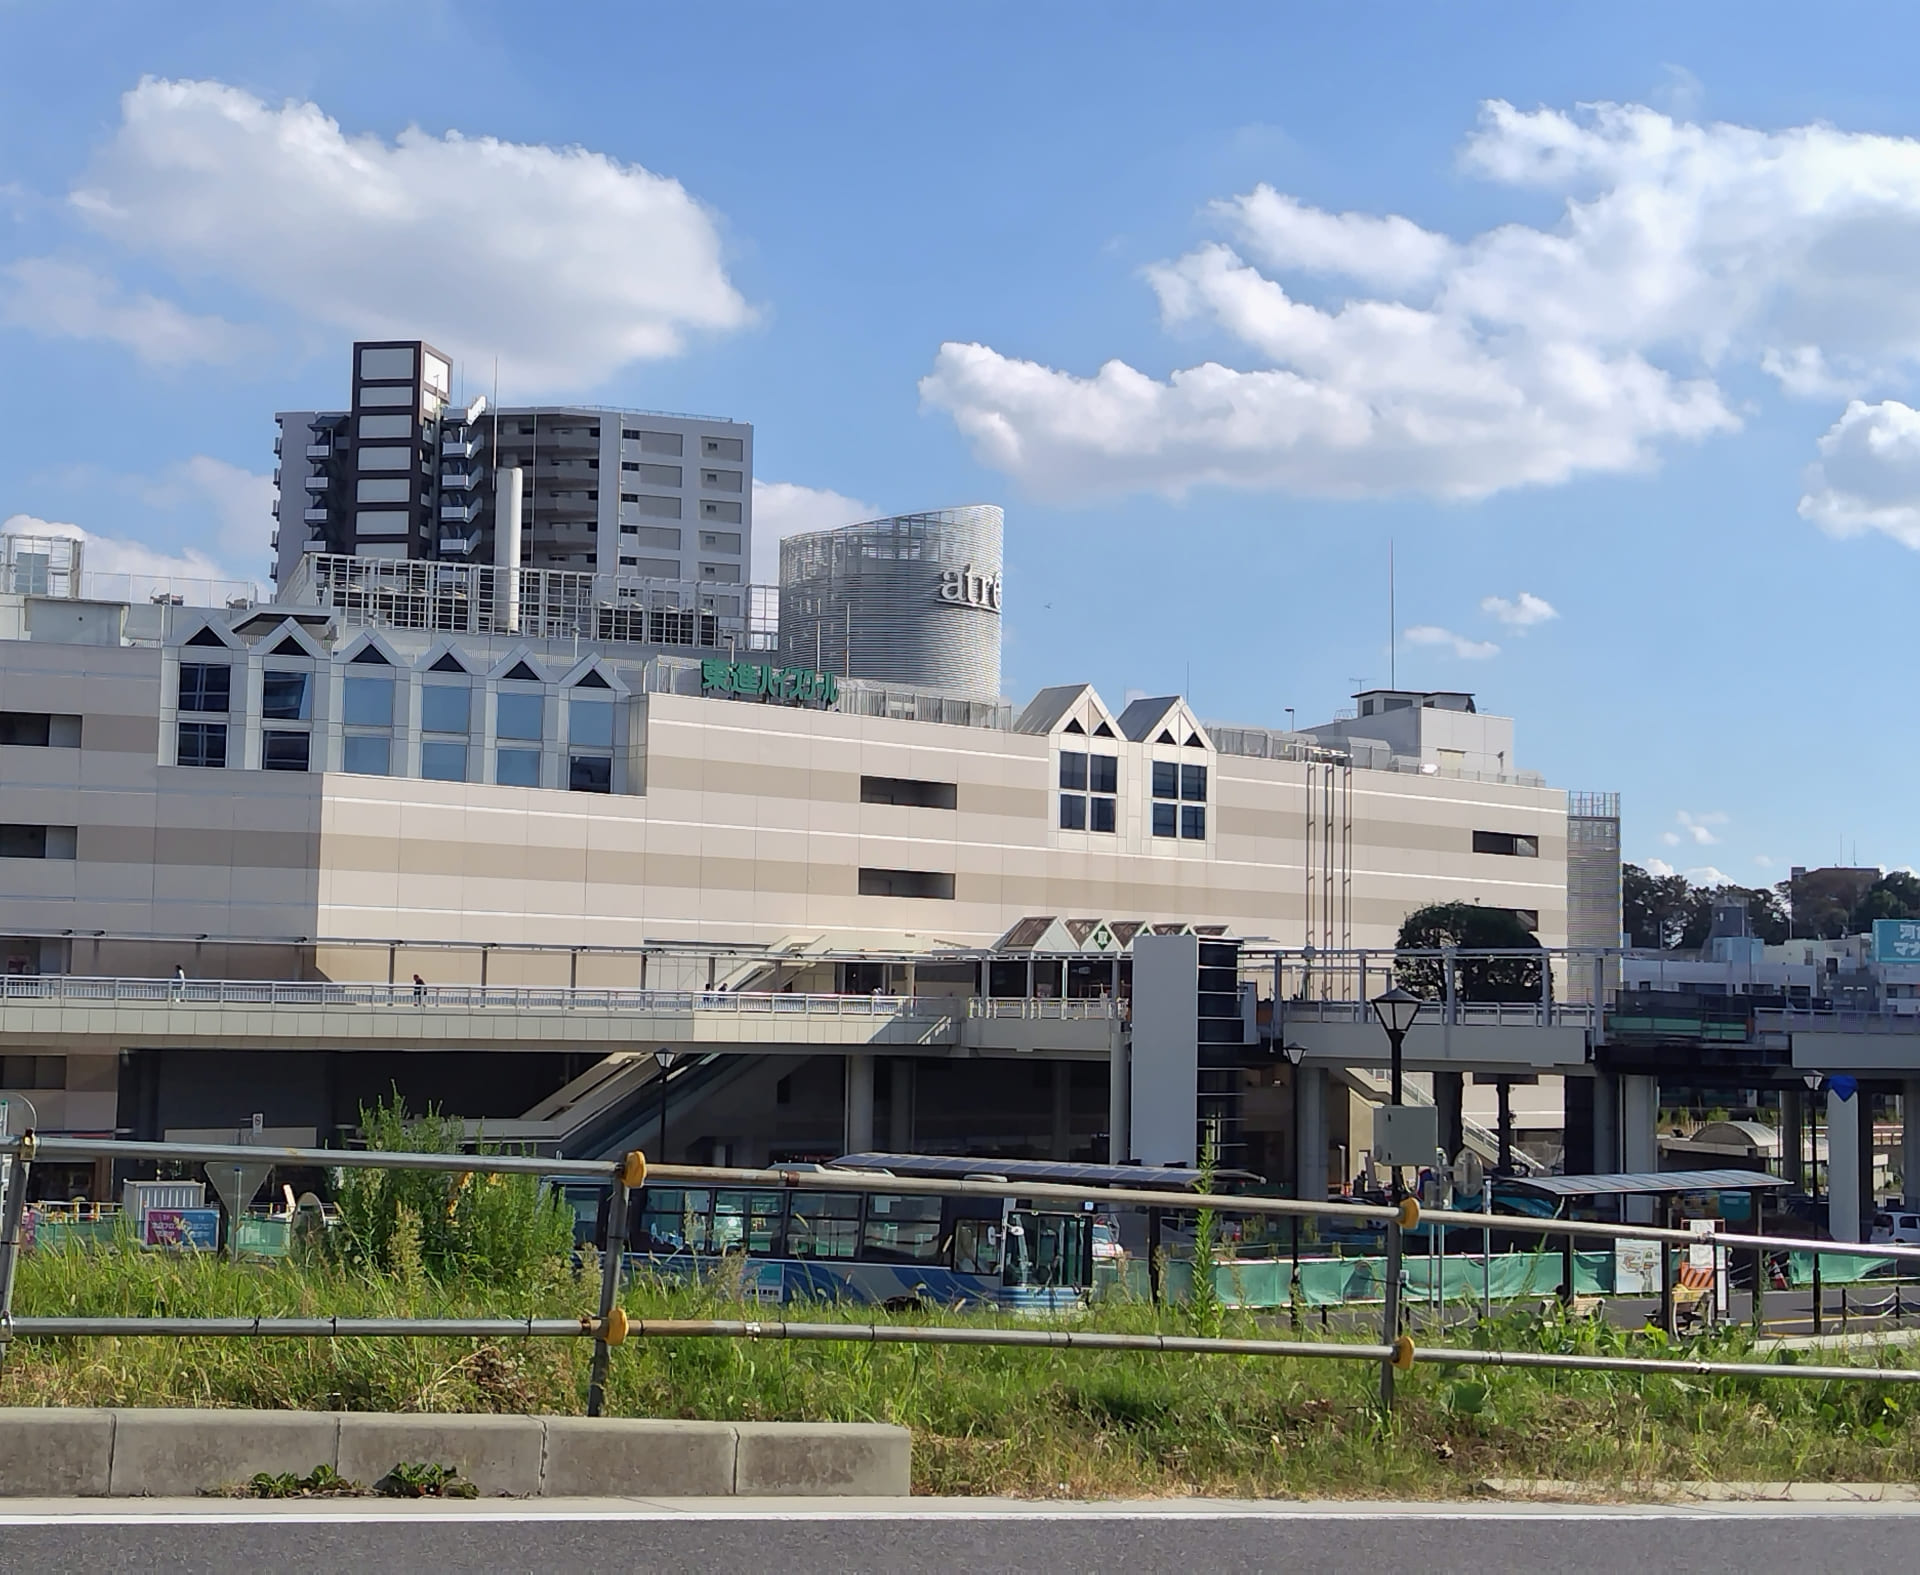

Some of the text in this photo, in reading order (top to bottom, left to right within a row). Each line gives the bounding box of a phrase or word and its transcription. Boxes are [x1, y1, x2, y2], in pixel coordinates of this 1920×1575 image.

[701, 659, 839, 704] 東進ハイスクール
